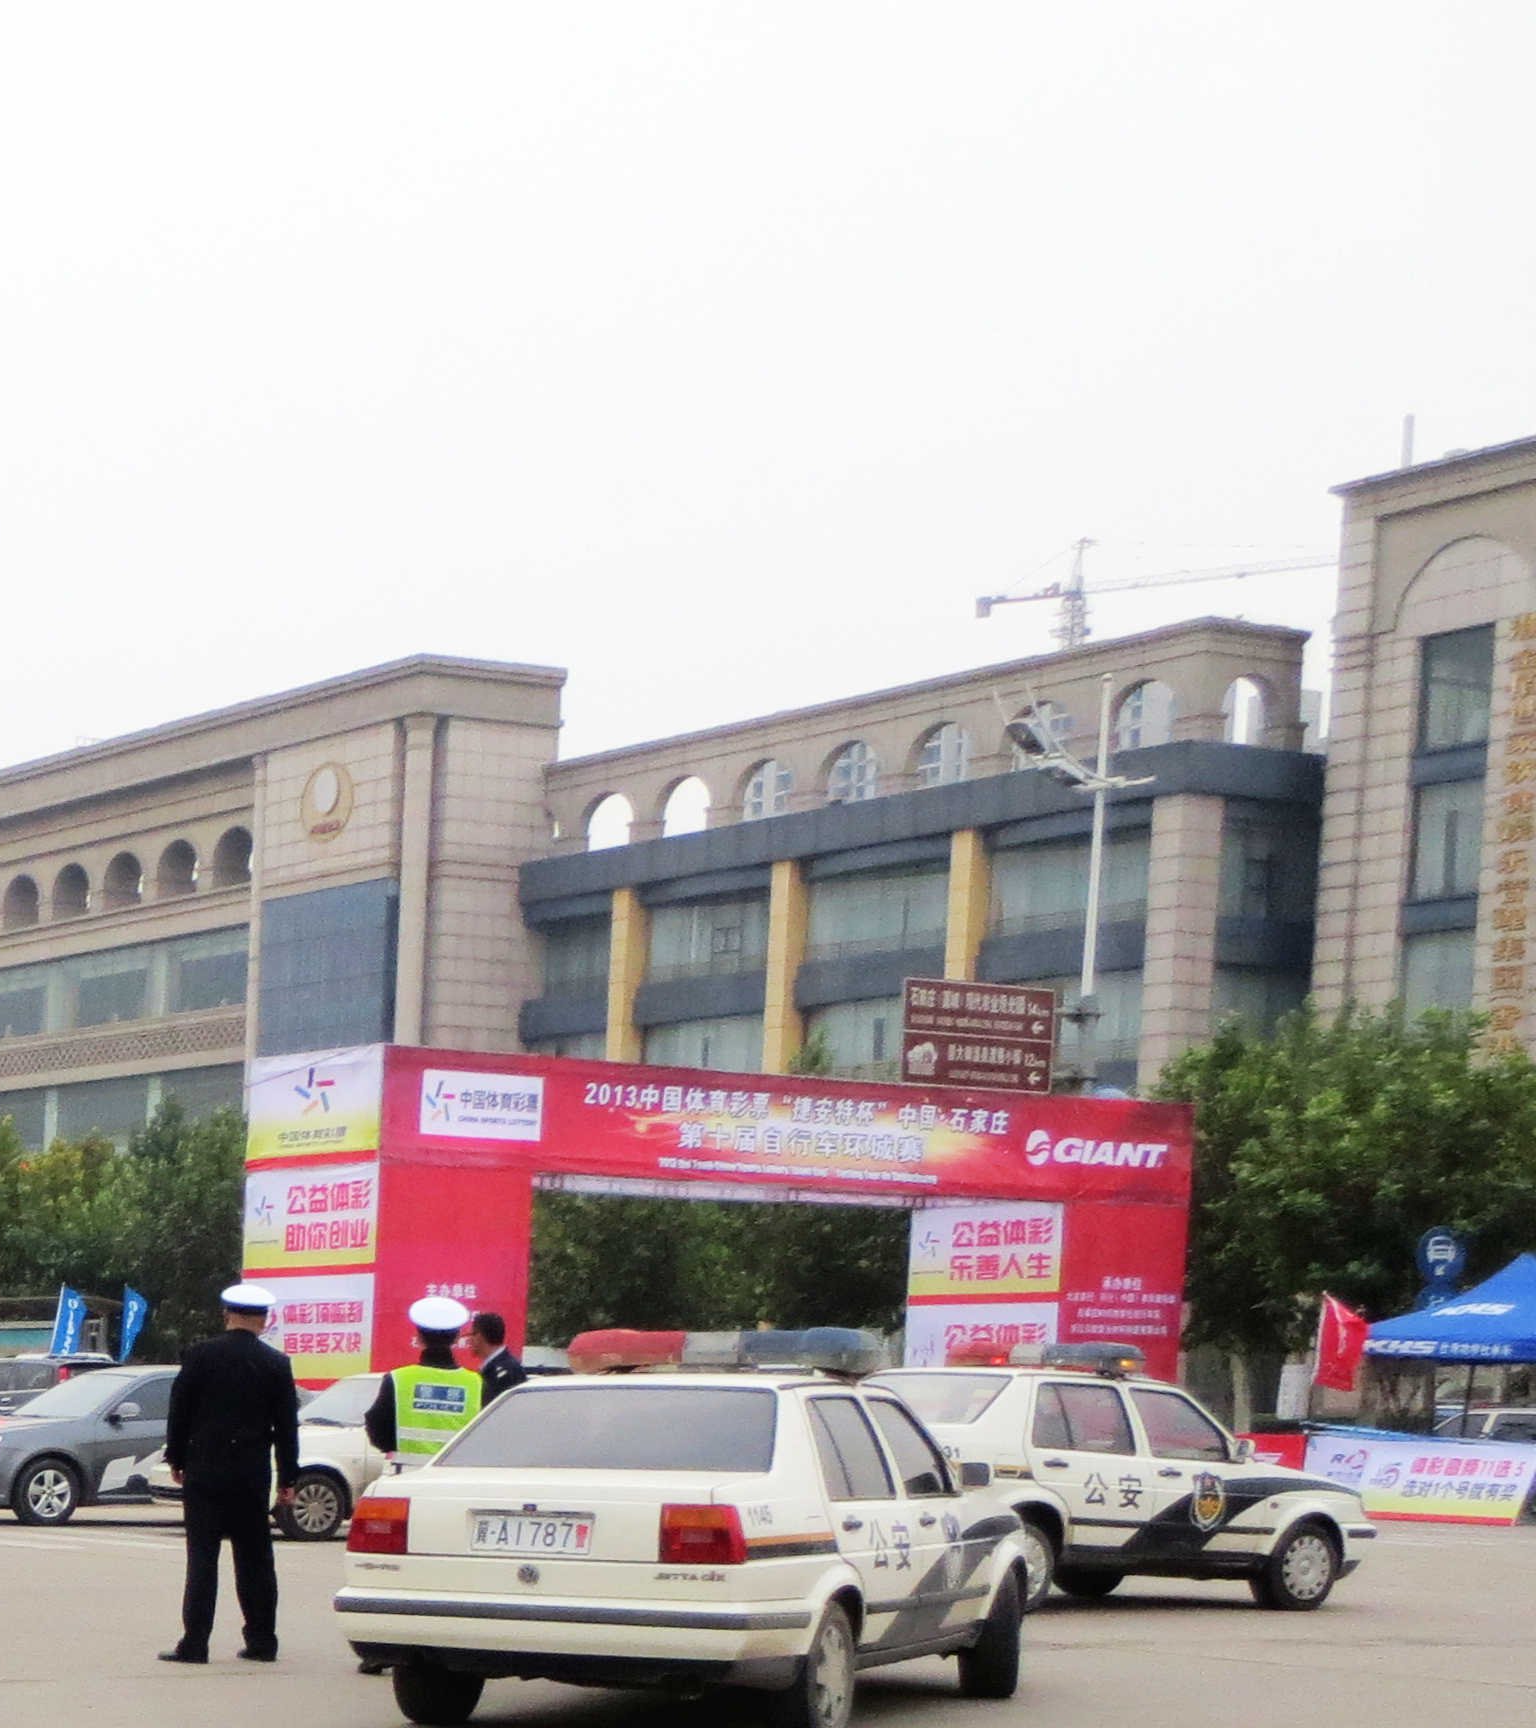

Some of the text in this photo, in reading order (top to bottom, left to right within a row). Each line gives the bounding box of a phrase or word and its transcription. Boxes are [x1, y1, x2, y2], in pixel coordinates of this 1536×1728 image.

[459, 1089, 539, 1113] 中国体育彩票
[584, 1082, 771, 1119] 2013中国体育彩票
[677, 1122, 924, 1162] 第十届自行车环城赛
[1053, 1137, 1168, 1168] GIANT
[286, 1176, 373, 1214] 公益体彩
[283, 1219, 369, 1252] 助你创业
[951, 1218, 1054, 1248] 公益体彩
[949, 1252, 1053, 1281] 乐善人生
[943, 1322, 1048, 1349] 公益体彩
[1364, 1339, 1439, 1354] KHS
[1083, 1472, 1144, 1510] 公安
[868, 1518, 912, 1572] 公安
